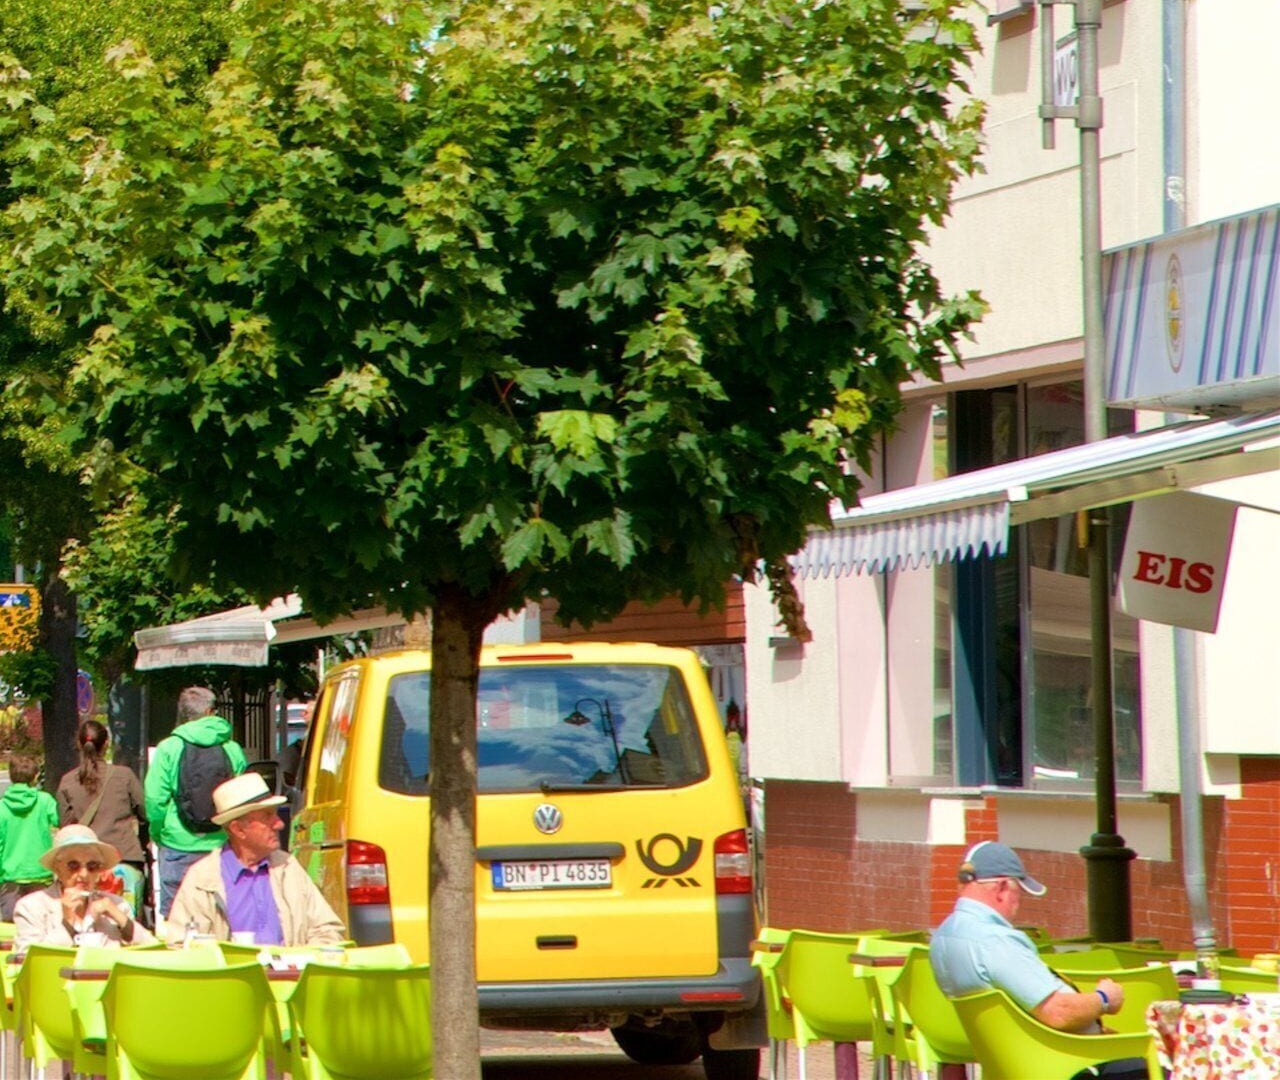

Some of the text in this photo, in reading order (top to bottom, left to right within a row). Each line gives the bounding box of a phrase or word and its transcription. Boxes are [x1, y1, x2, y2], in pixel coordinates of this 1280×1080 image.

[1133, 550, 1215, 594] EIS
[504, 862, 608, 883] BN PI 4835
